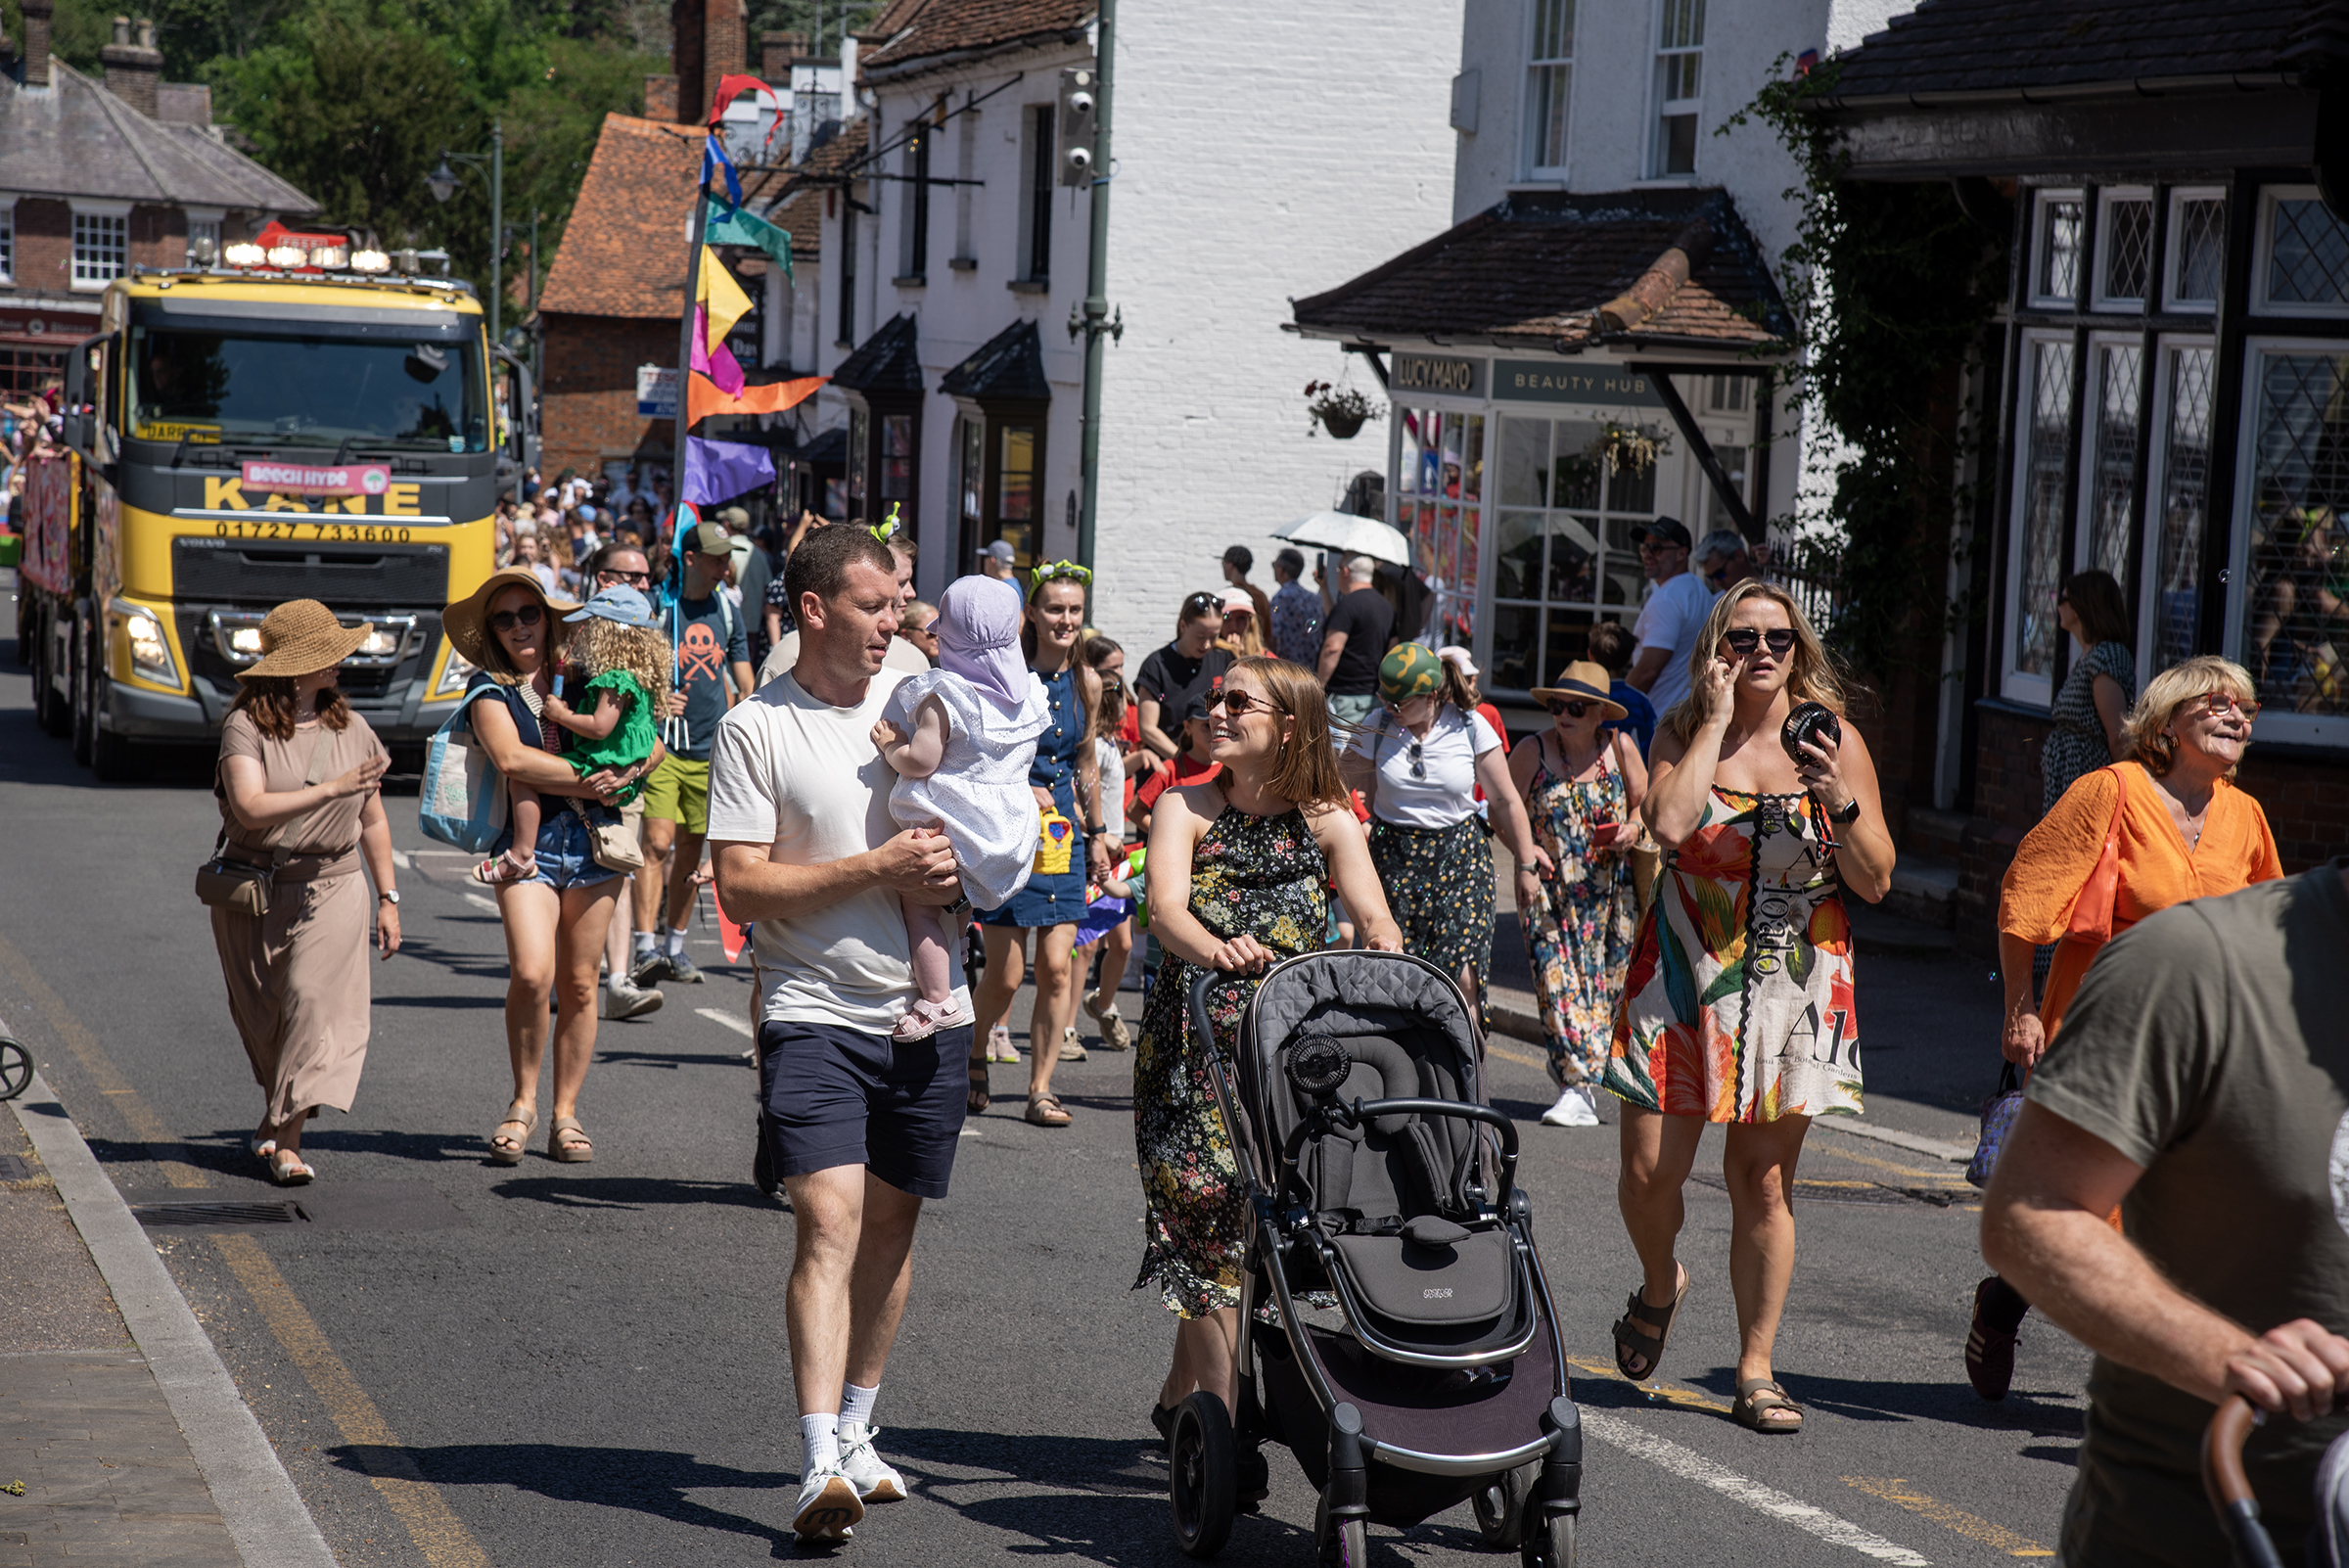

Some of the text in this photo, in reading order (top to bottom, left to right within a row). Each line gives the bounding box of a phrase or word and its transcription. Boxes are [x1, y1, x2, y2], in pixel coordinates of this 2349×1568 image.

[1399, 357, 1471, 391] LUCY MAYO
[1514, 373, 1646, 393] BEAUTY HUB
[178, 537, 226, 549] VOLVO
[215, 523, 411, 544] 01727 733600
[1822, 1063, 1858, 1080] Gardens
